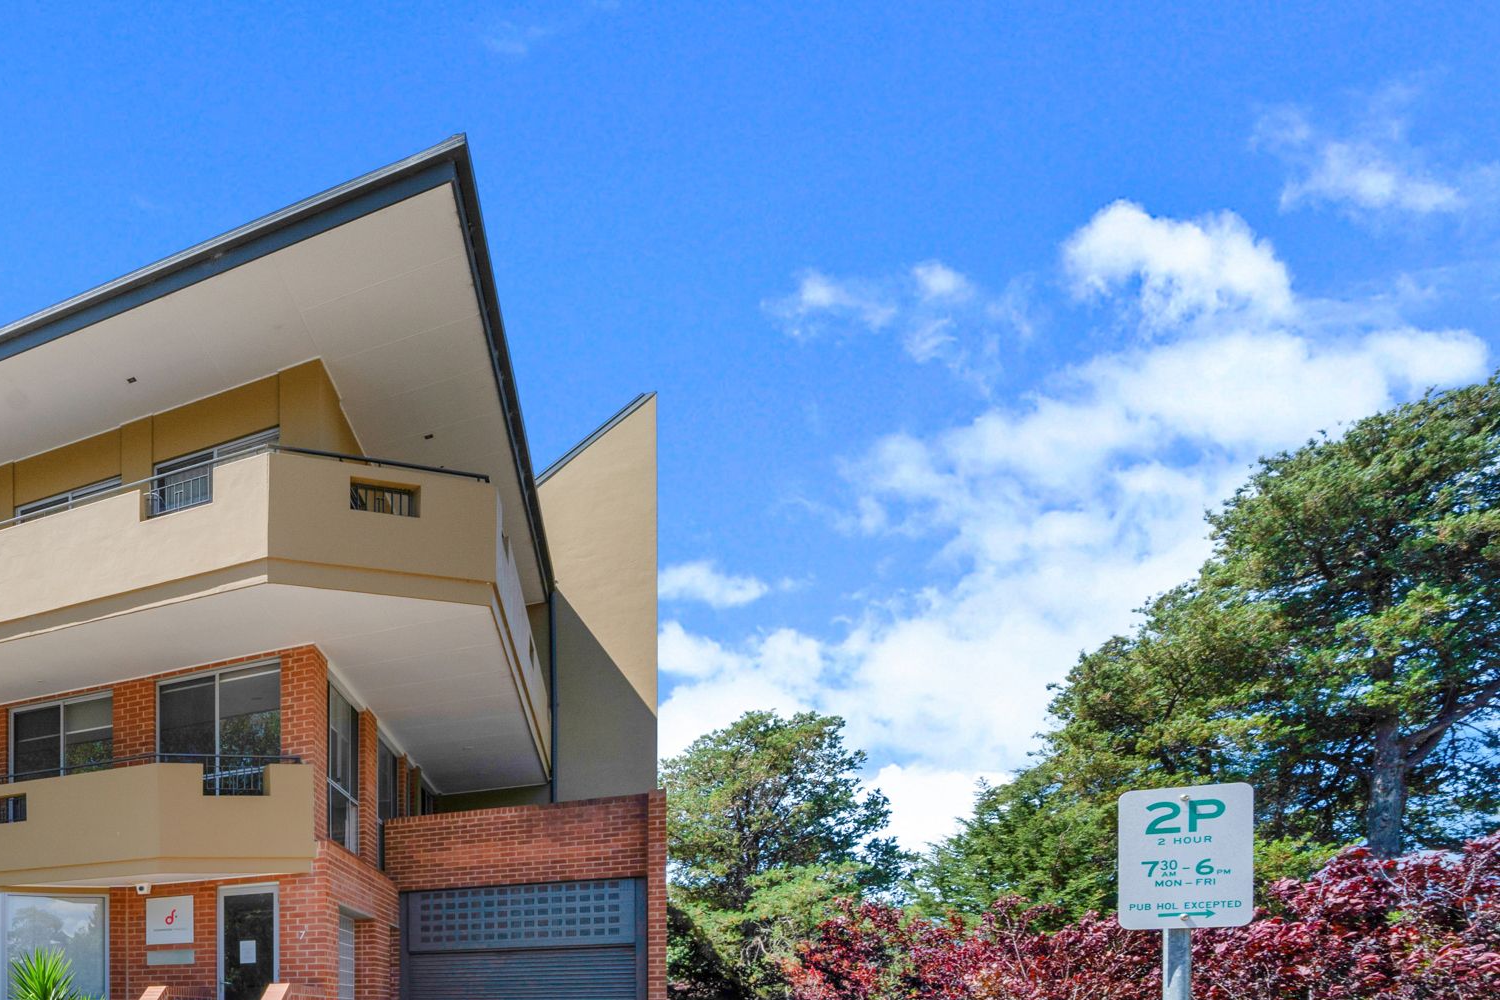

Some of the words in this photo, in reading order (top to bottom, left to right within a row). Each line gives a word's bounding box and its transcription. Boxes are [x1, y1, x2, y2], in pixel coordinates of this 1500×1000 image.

[1145, 798, 1226, 835] 2P
[1157, 838, 1166, 846] 2
[1173, 835, 1213, 845] HOUR
[1155, 879, 1182, 888] MON
[1195, 878, 1216, 886] FRI
[1129, 903, 1151, 911] PUB
[1156, 902, 1178, 910] HOL
[1184, 900, 1242, 910] EXCEPTED
